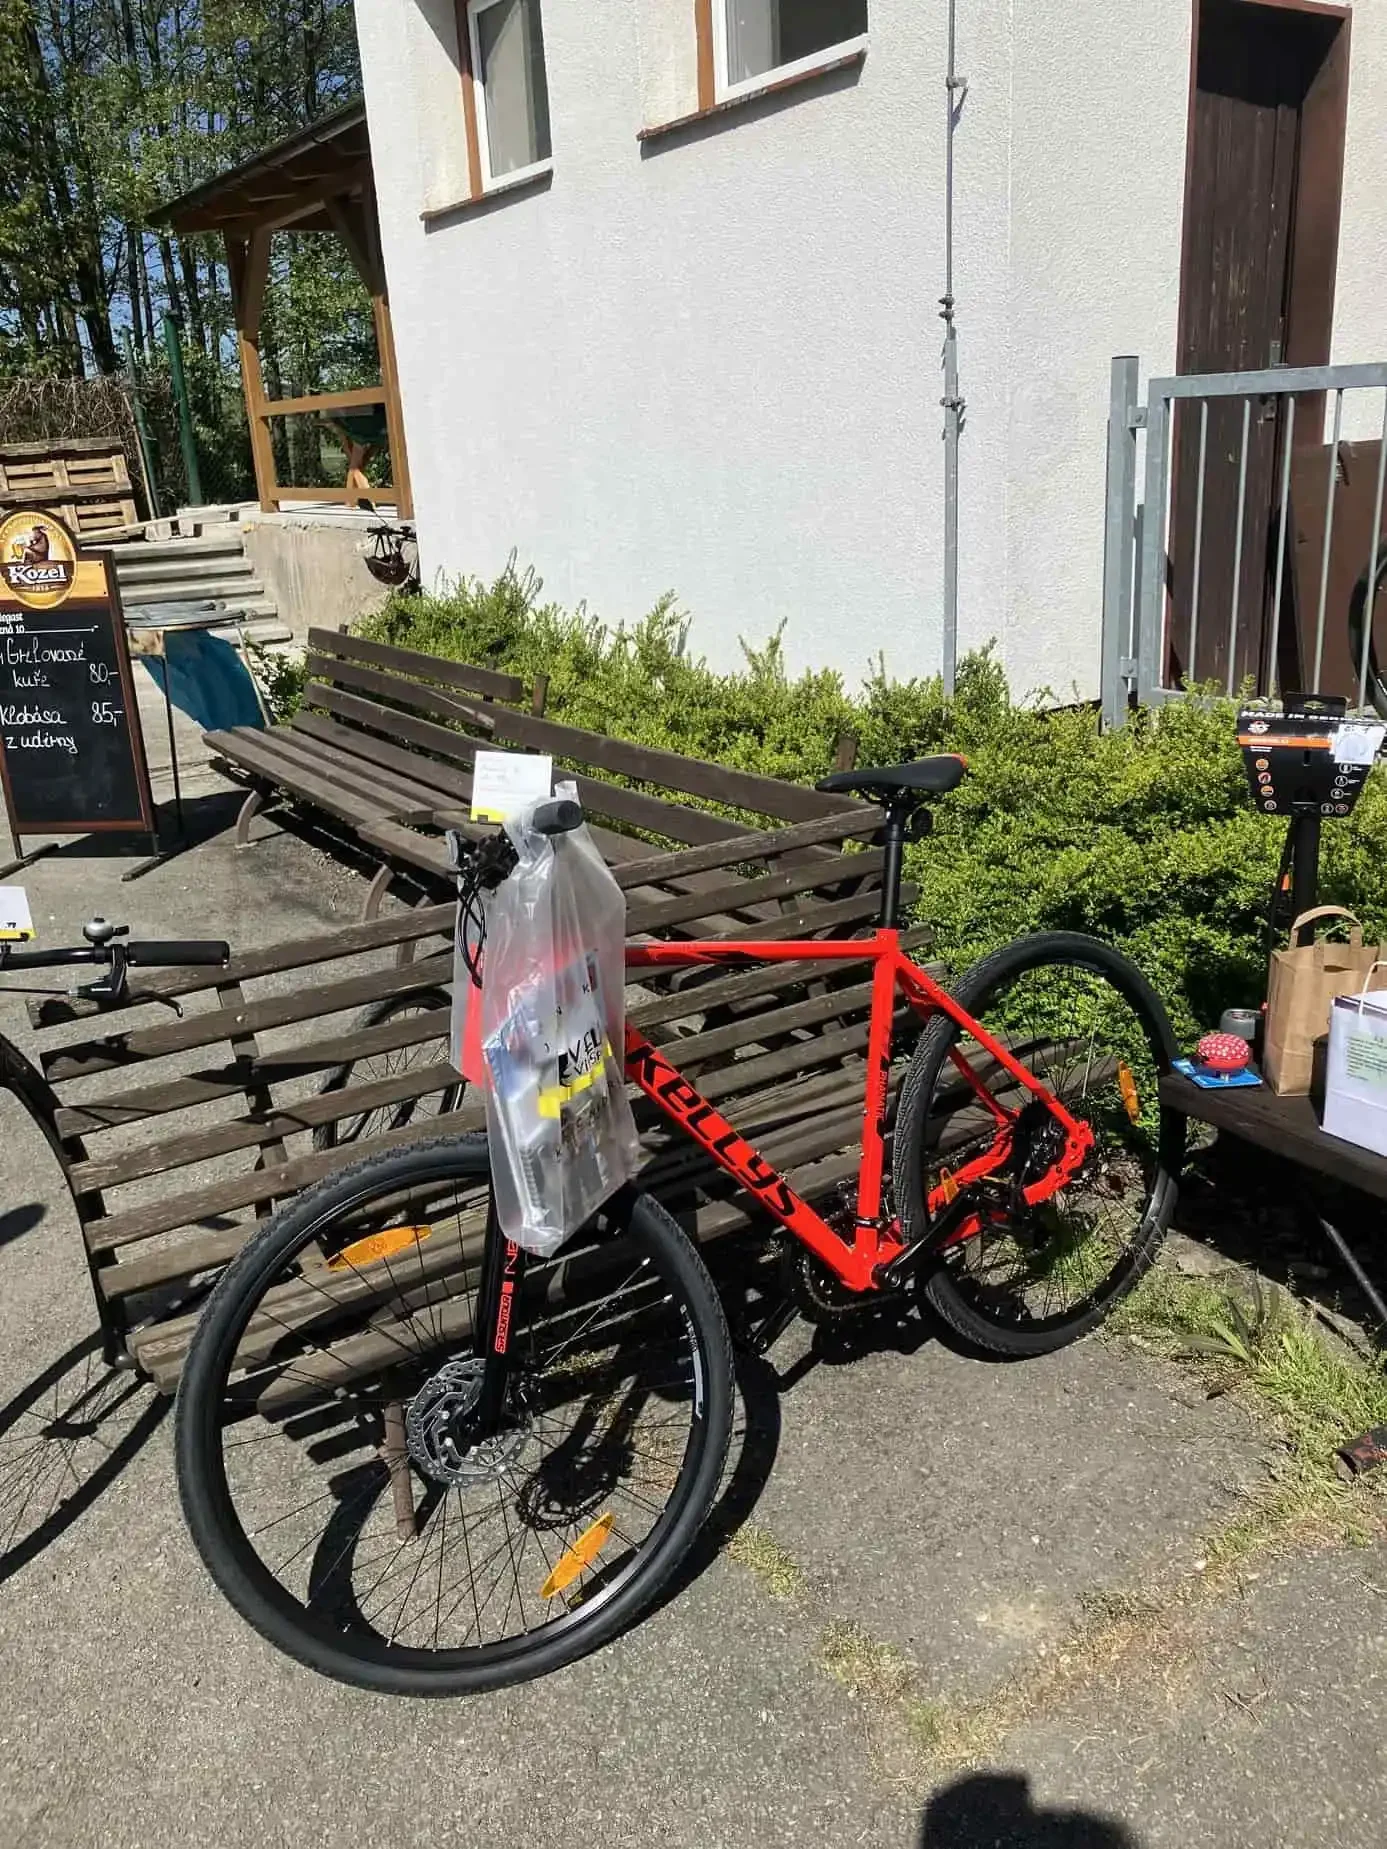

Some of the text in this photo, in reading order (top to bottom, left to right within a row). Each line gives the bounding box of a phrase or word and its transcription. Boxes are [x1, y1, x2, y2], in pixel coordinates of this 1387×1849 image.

[8, 564, 67, 584] Kozel
[12, 669, 51, 688] kuře
[0, 704, 68, 726] Klobása
[1240, 710, 1285, 719] MADE
